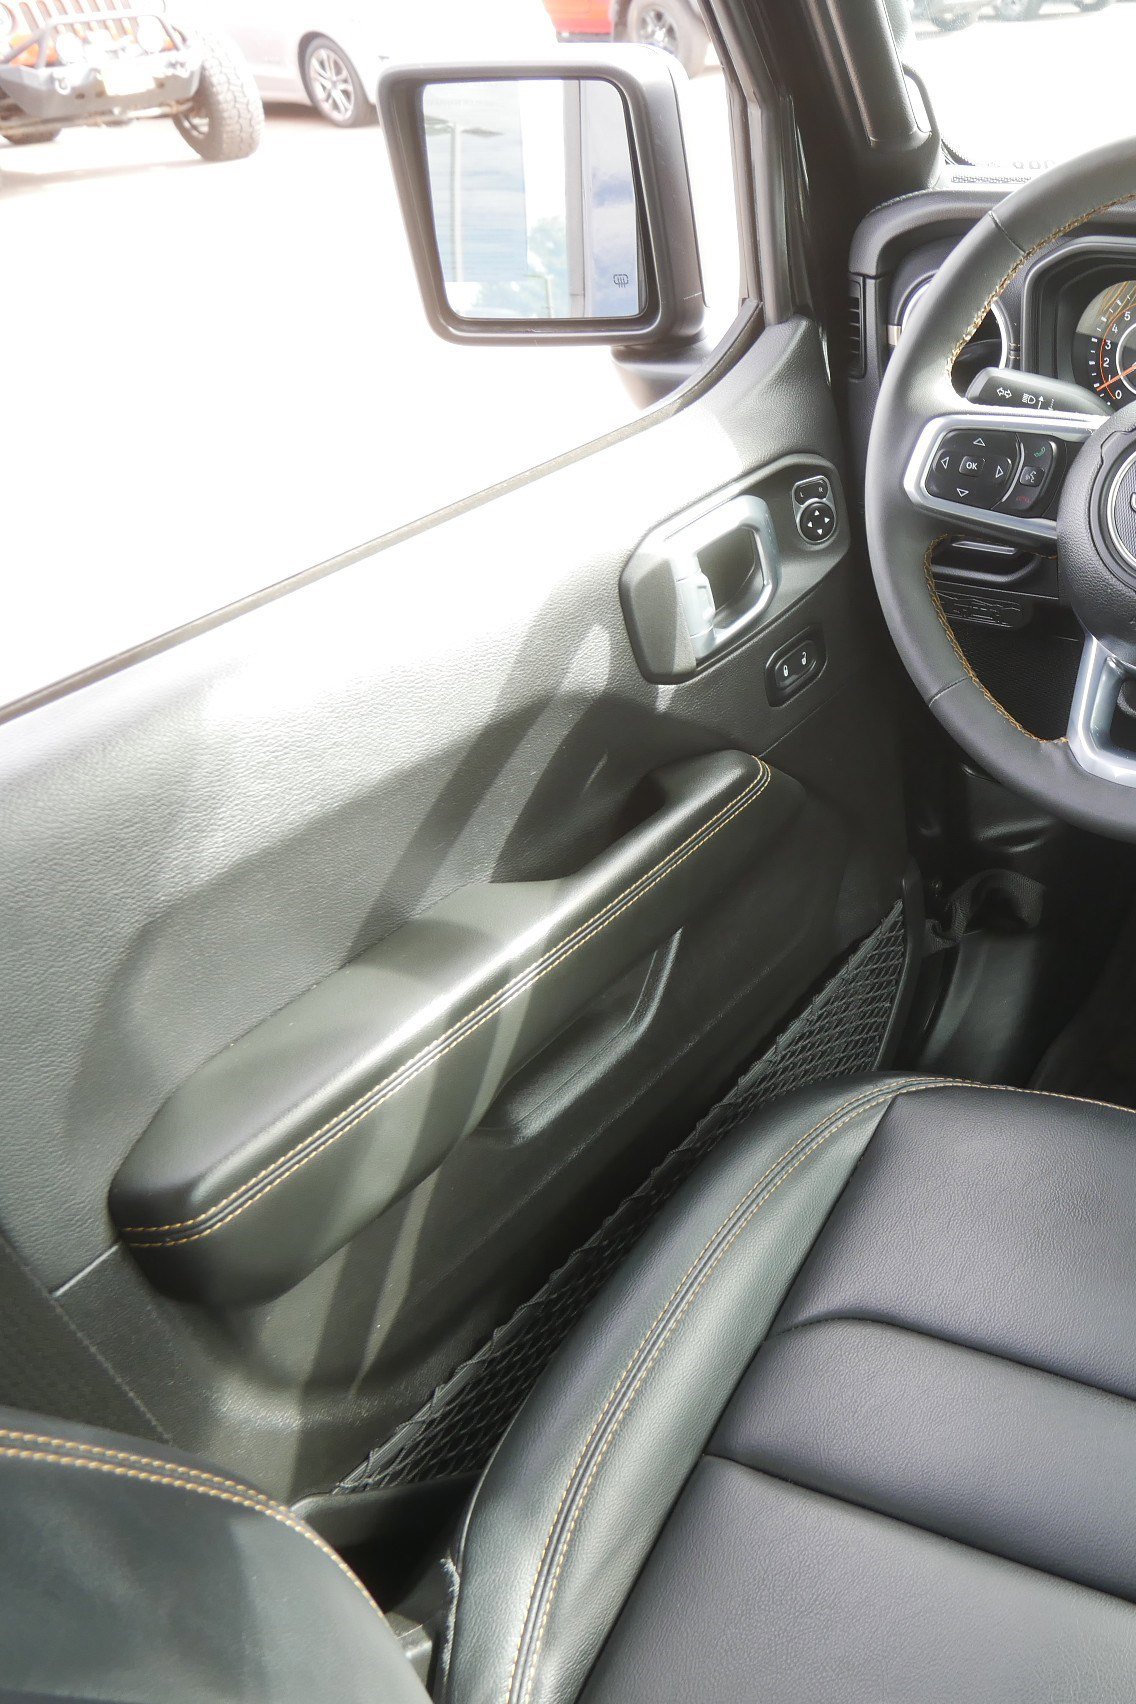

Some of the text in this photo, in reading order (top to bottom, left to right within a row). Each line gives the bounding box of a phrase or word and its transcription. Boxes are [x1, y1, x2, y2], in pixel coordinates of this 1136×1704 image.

[1124, 311, 1131, 321] 5
[1112, 324, 1118, 333] 4
[1105, 340, 1111, 350] 3
[1103, 358, 1109, 368] 2
[1115, 390, 1122, 399] 0
[966, 461, 978, 471] OK
